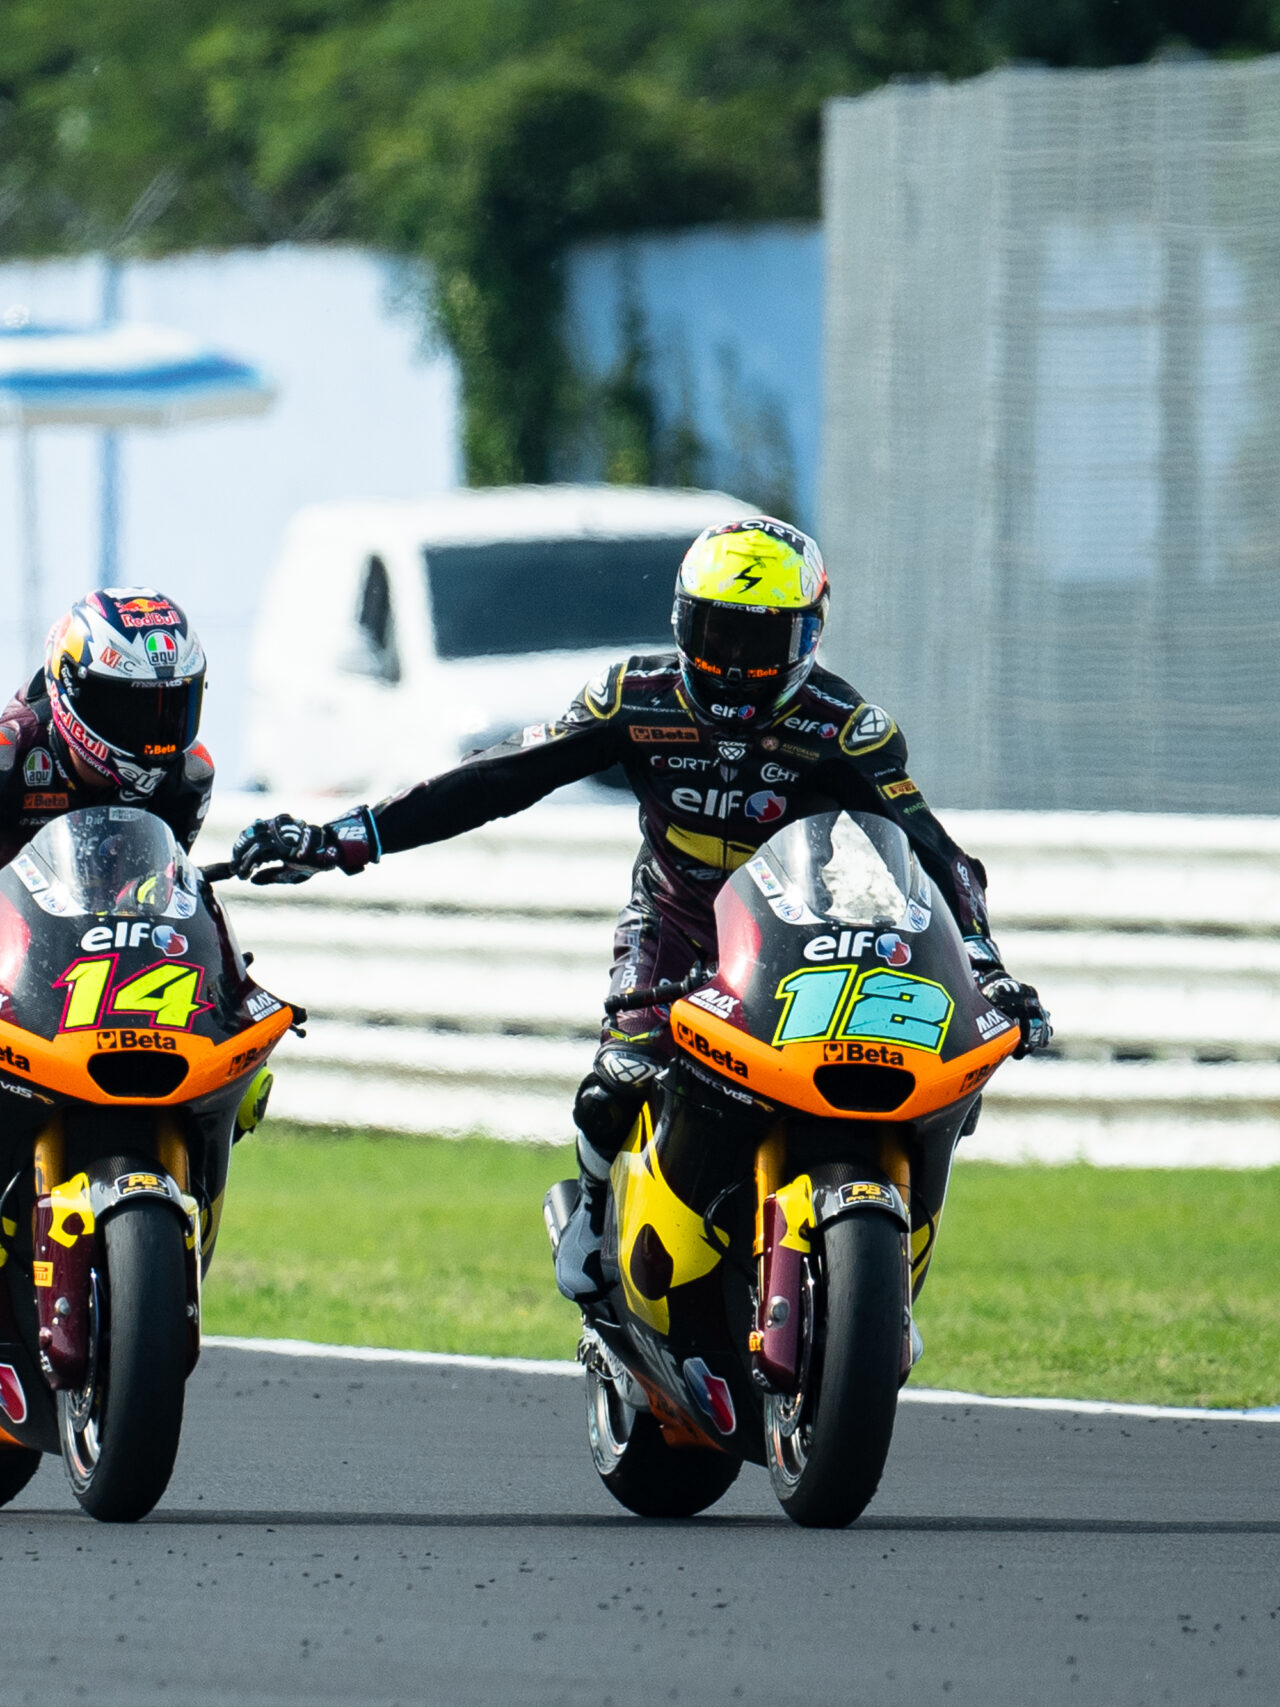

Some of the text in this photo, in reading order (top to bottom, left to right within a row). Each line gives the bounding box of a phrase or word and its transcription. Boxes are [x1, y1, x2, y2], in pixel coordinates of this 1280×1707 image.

[120, 610, 181, 628] Red Bull
[701, 660, 722, 676] Beta
[756, 667, 778, 678] Beta
[710, 703, 738, 718] elf
[651, 728, 697, 741] Beta
[783, 717, 820, 733] elf
[70, 720, 109, 761] Bull
[153, 744, 176, 755] Beta
[672, 787, 744, 820] elf
[338, 826, 366, 841] 12
[81, 921, 151, 952] elf
[803, 930, 874, 961] elf
[52, 952, 215, 1033] 14
[246, 991, 279, 1015] MAX
[693, 987, 741, 1013] MAX
[772, 964, 955, 1055] 12
[975, 1008, 1004, 1034] MAX
[120, 1030, 177, 1051] Beta
[695, 1032, 749, 1080] Beta
[846, 1043, 904, 1066] Beta
